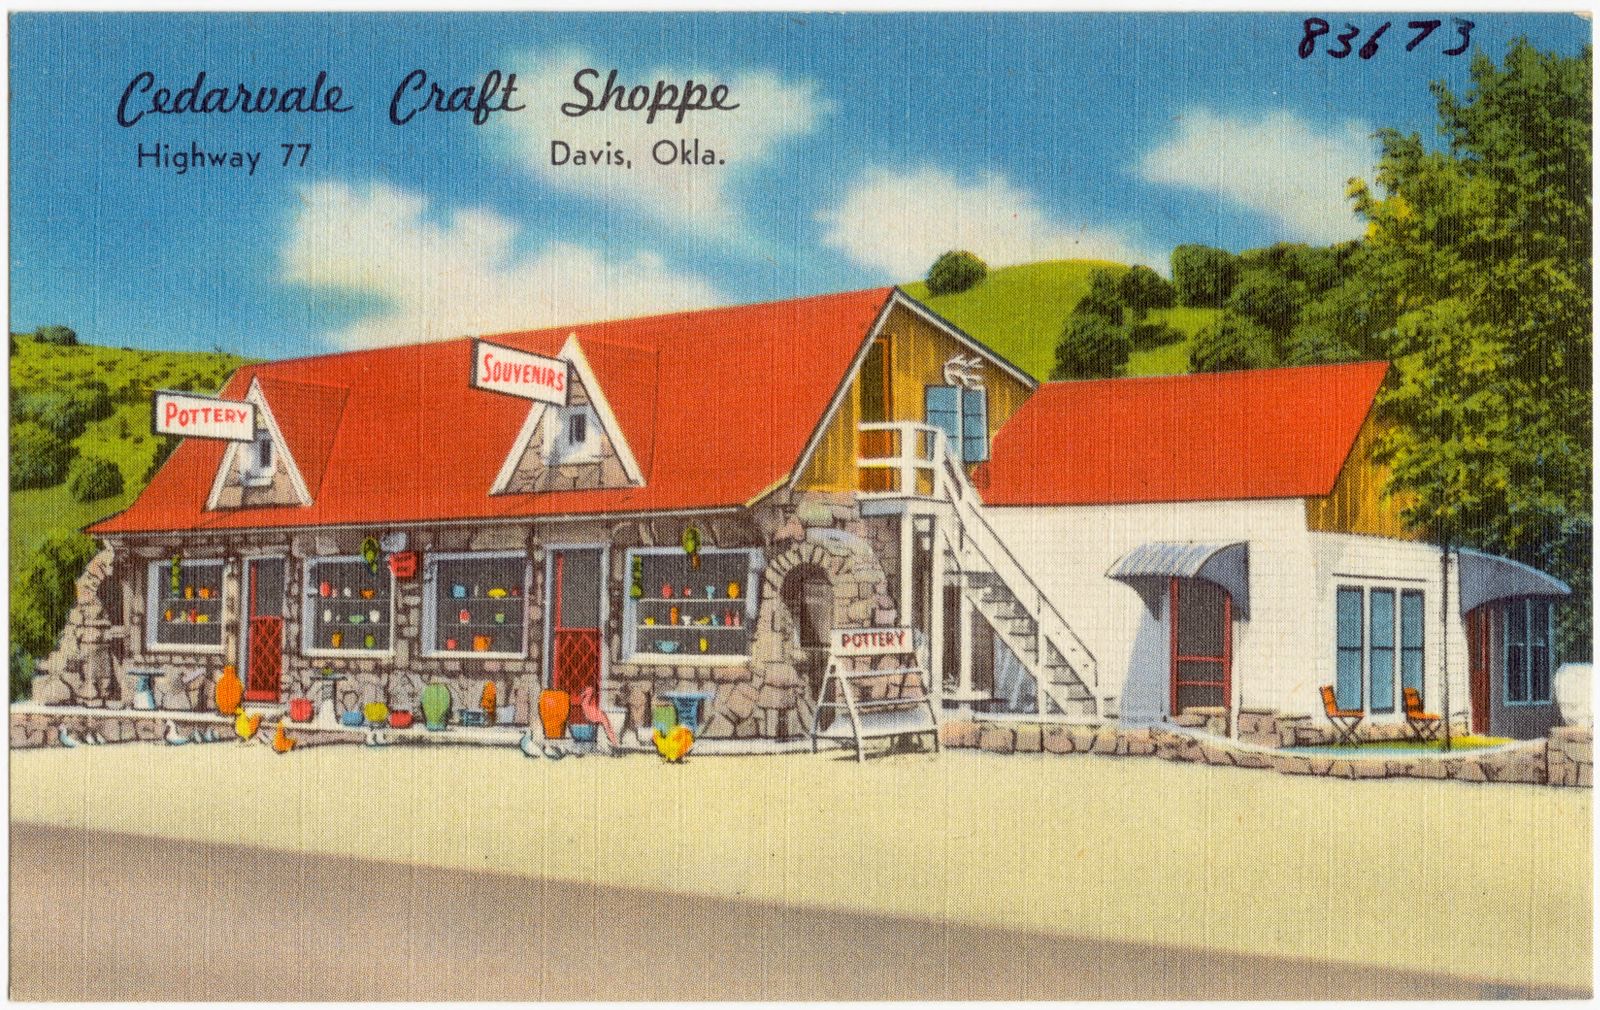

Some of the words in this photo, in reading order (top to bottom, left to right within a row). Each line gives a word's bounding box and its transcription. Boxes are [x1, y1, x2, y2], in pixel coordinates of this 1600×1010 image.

[481, 353, 565, 393] SOUVENIRS
[165, 401, 248, 428] POTTERY
[842, 630, 905, 648] POTTERY
